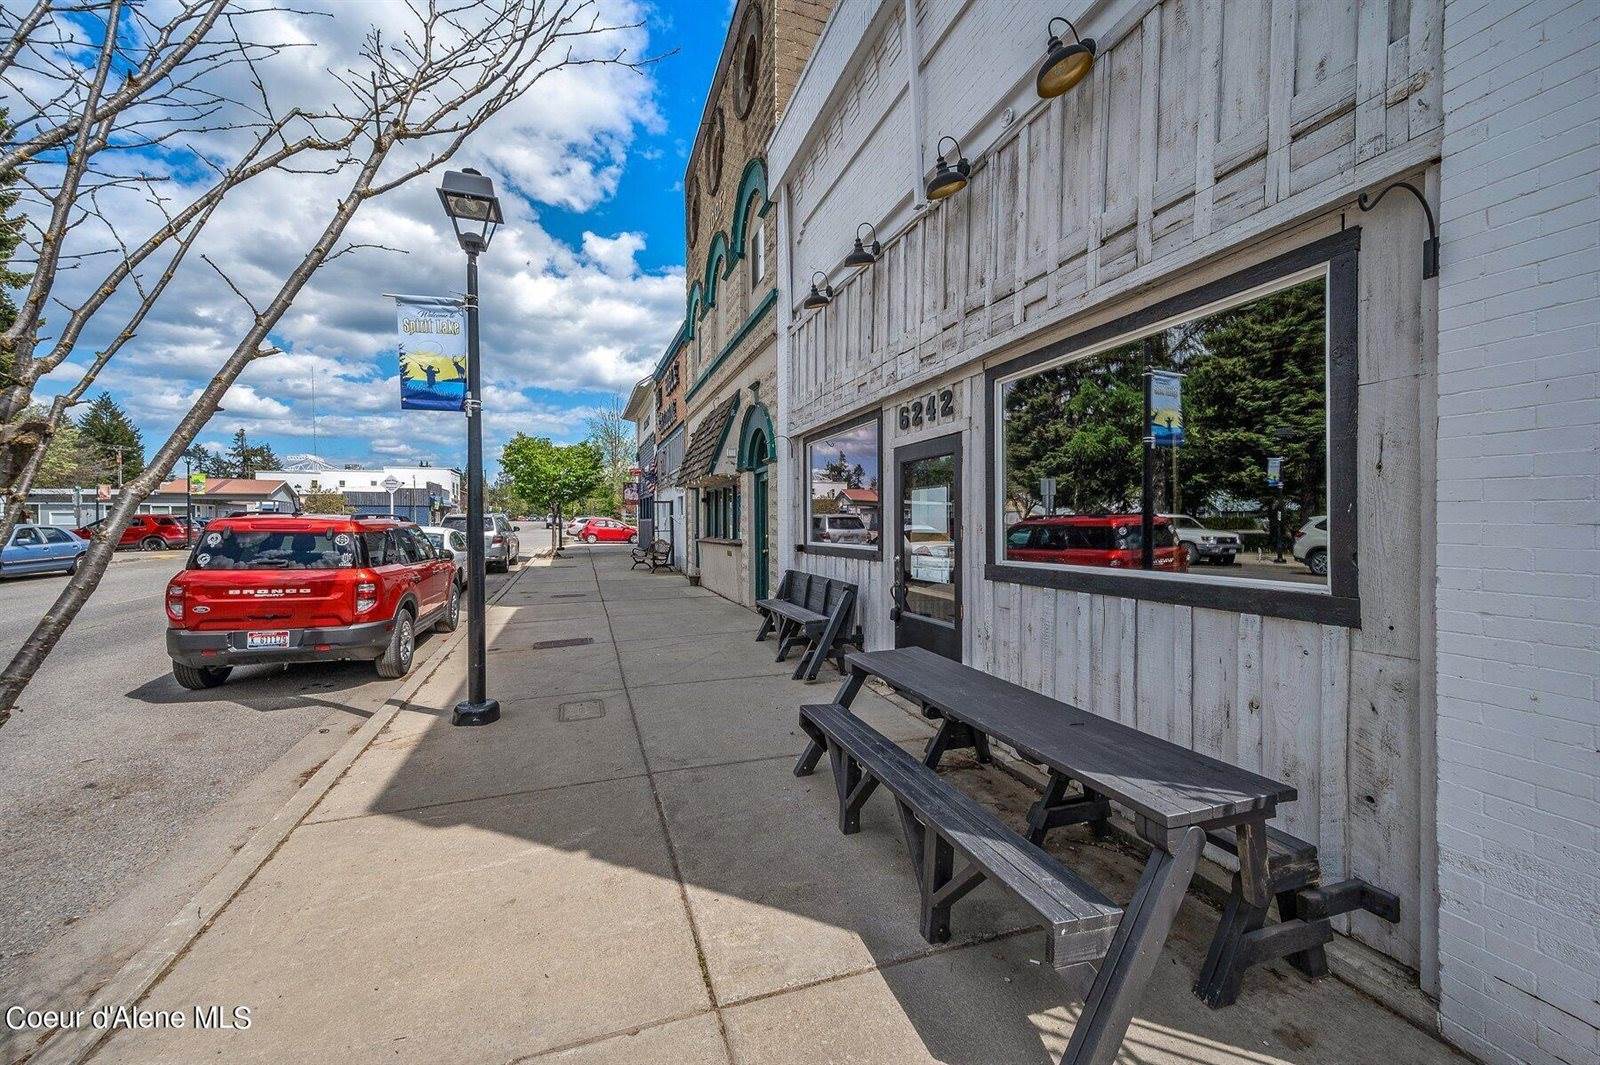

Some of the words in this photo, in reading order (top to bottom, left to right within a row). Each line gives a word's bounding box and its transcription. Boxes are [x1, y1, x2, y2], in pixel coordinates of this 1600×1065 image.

[403, 317, 433, 335] Spirit
[435, 318, 460, 335] Lake
[899, 389, 954, 430] 6242
